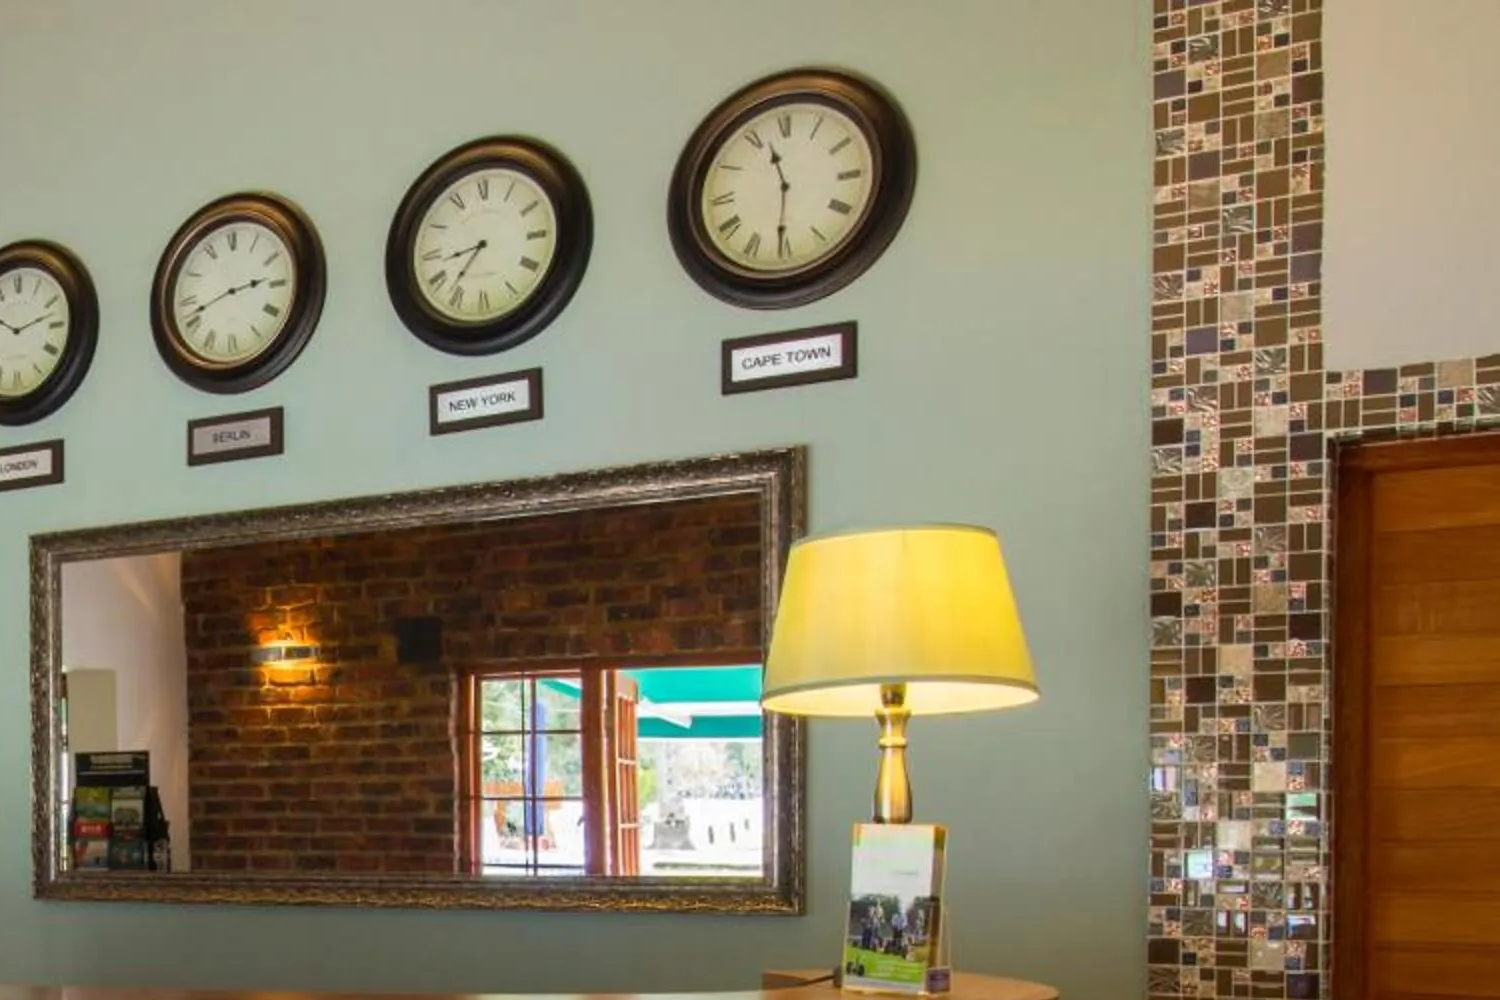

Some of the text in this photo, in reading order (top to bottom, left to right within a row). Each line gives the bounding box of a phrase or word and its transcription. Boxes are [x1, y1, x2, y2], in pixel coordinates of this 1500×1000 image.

[741, 344, 831, 370] CAPE TOWN
[449, 391, 516, 412] NEW YORK
[0, 459, 38, 473] LONDON
